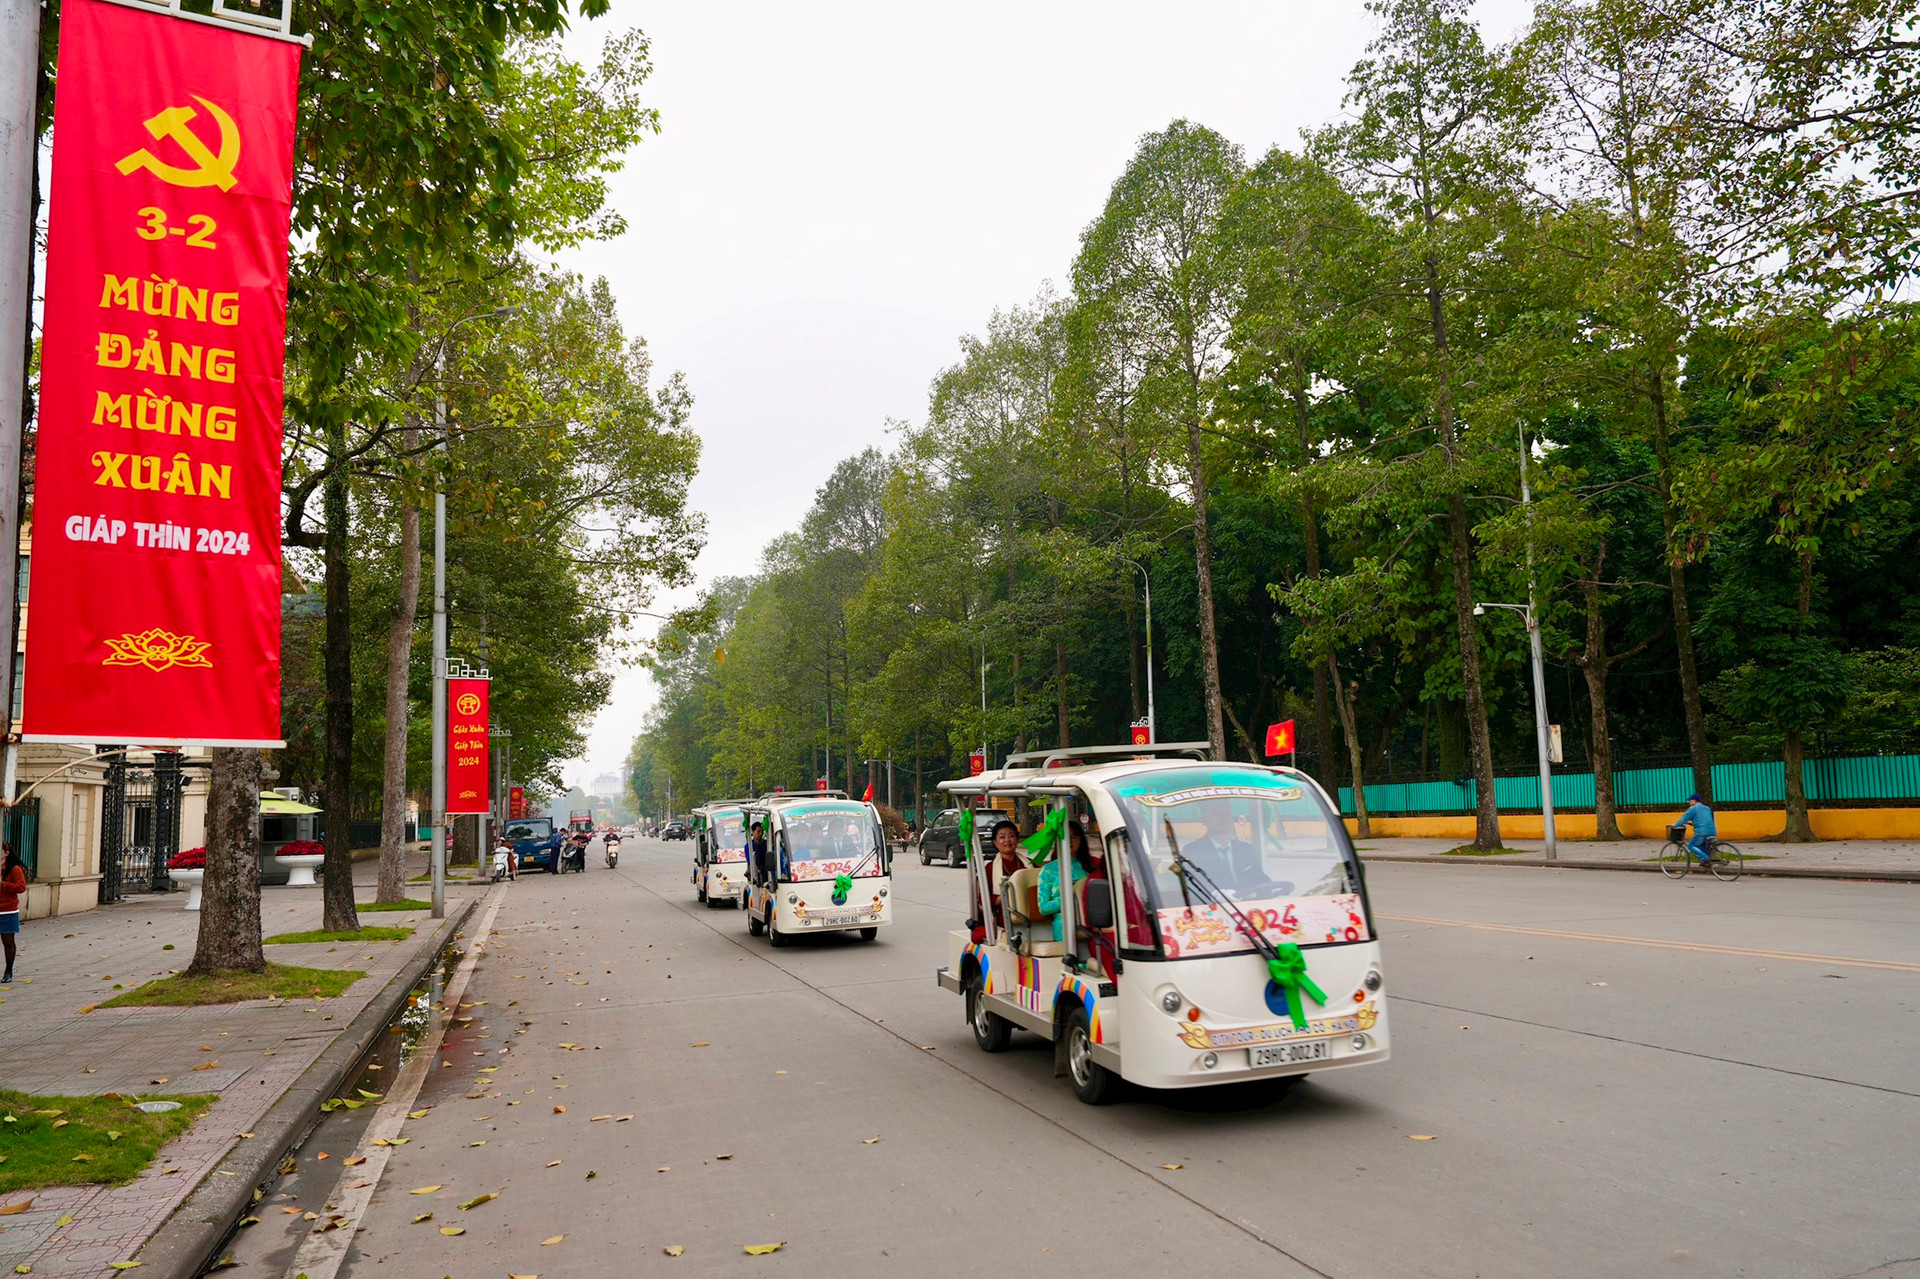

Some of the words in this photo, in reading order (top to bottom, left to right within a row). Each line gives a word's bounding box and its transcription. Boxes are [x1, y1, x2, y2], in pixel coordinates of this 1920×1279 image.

[136, 206, 217, 250] 3-2
[98, 273, 240, 326] MỪNG
[95, 329, 236, 384] ĐẢNG
[92, 388, 237, 442] MỪNG
[91, 450, 233, 499] XUÂN
[65, 514, 126, 545] GIÁP
[133, 519, 191, 552] THÌN
[196, 527, 251, 556] 2024
[458, 756, 480, 766] 2024
